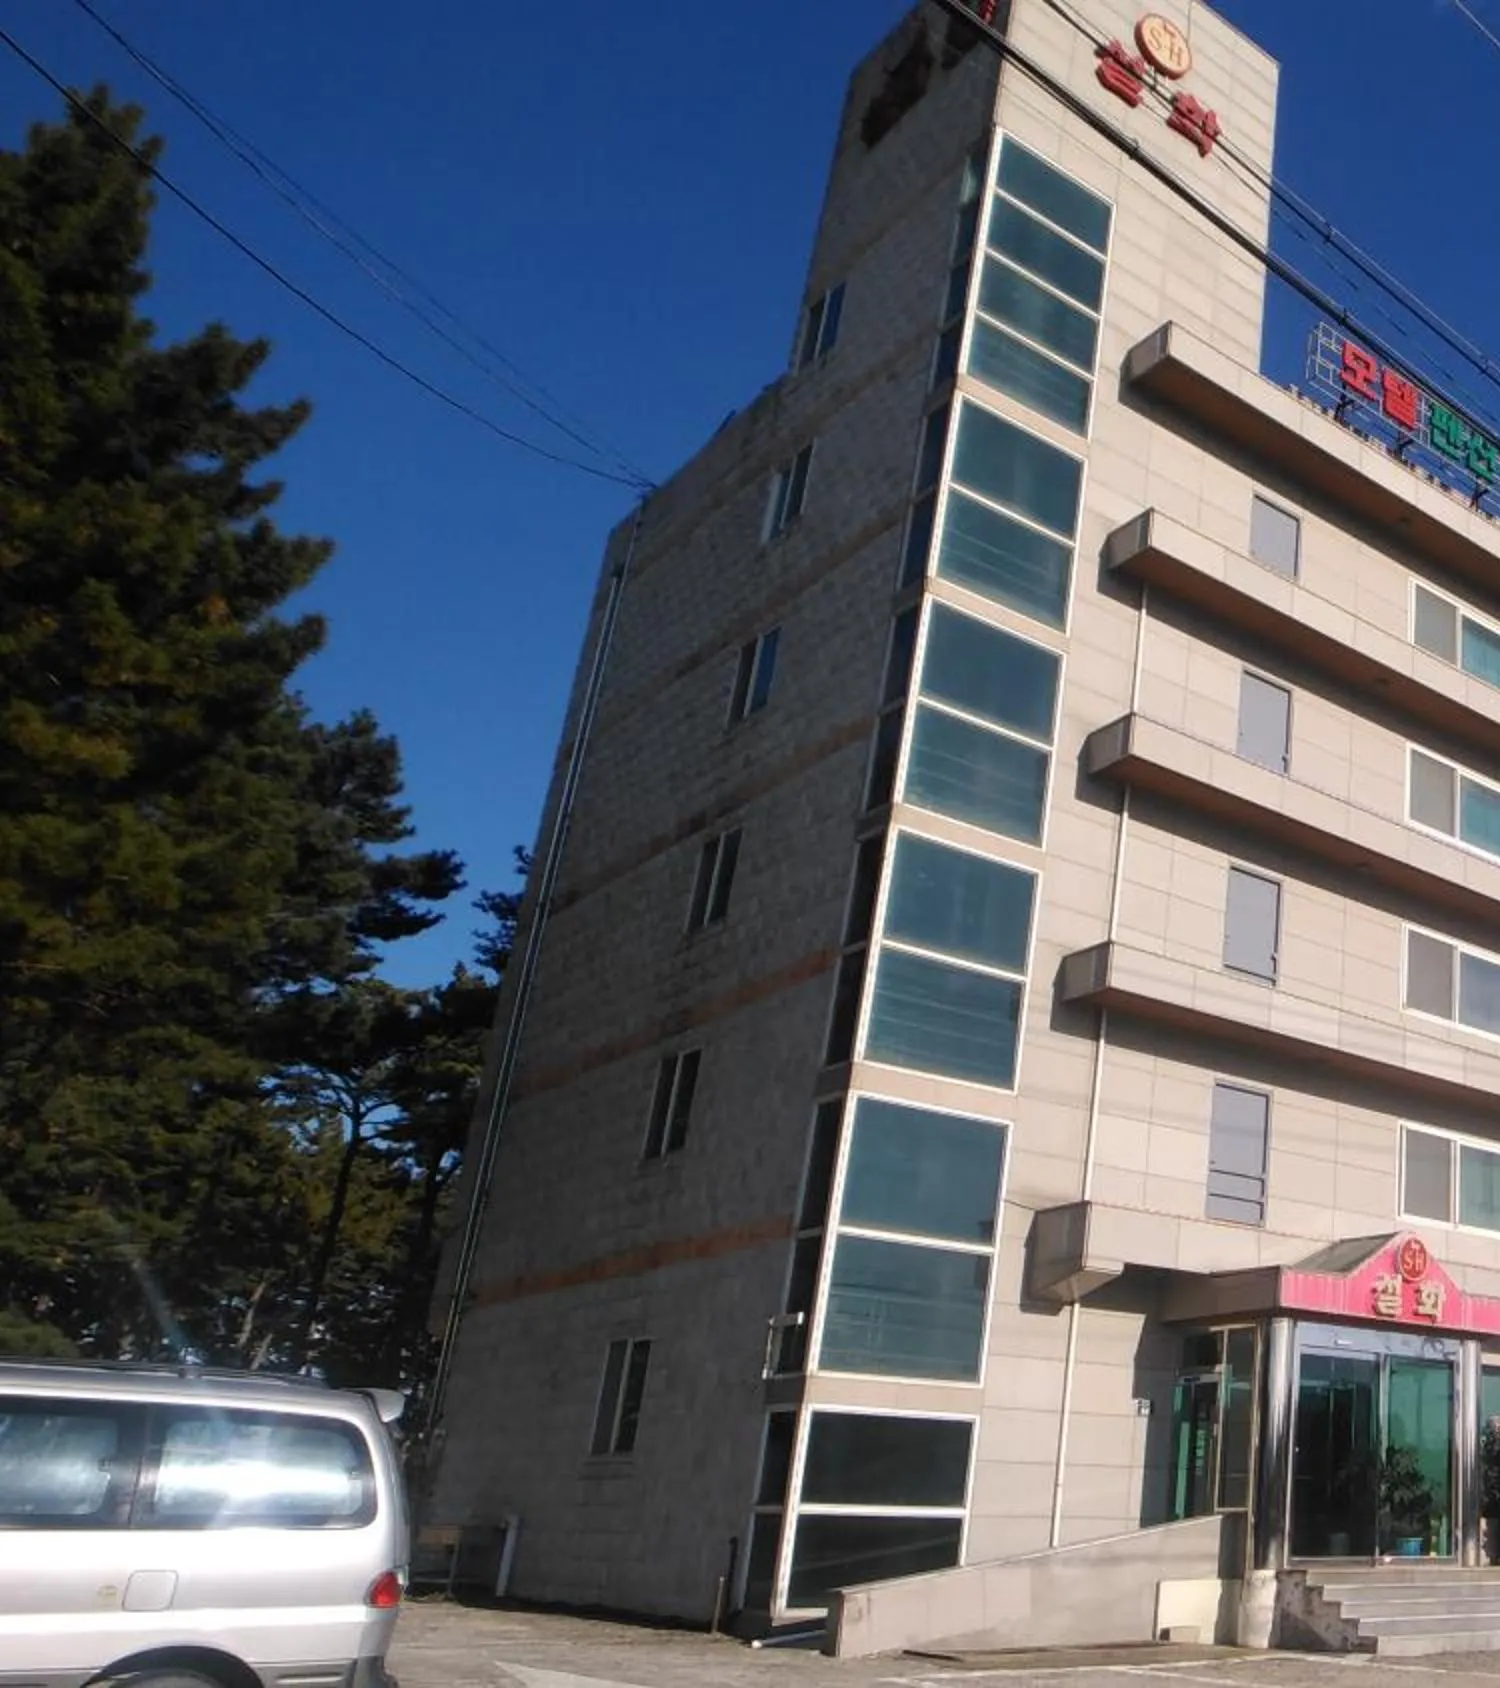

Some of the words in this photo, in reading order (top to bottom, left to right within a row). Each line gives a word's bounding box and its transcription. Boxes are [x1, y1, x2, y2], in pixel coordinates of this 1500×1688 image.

[1341, 340, 1417, 430] 모텔
[1430, 402, 1499, 483] 펜션
[1376, 1273, 1446, 1323] 설화
